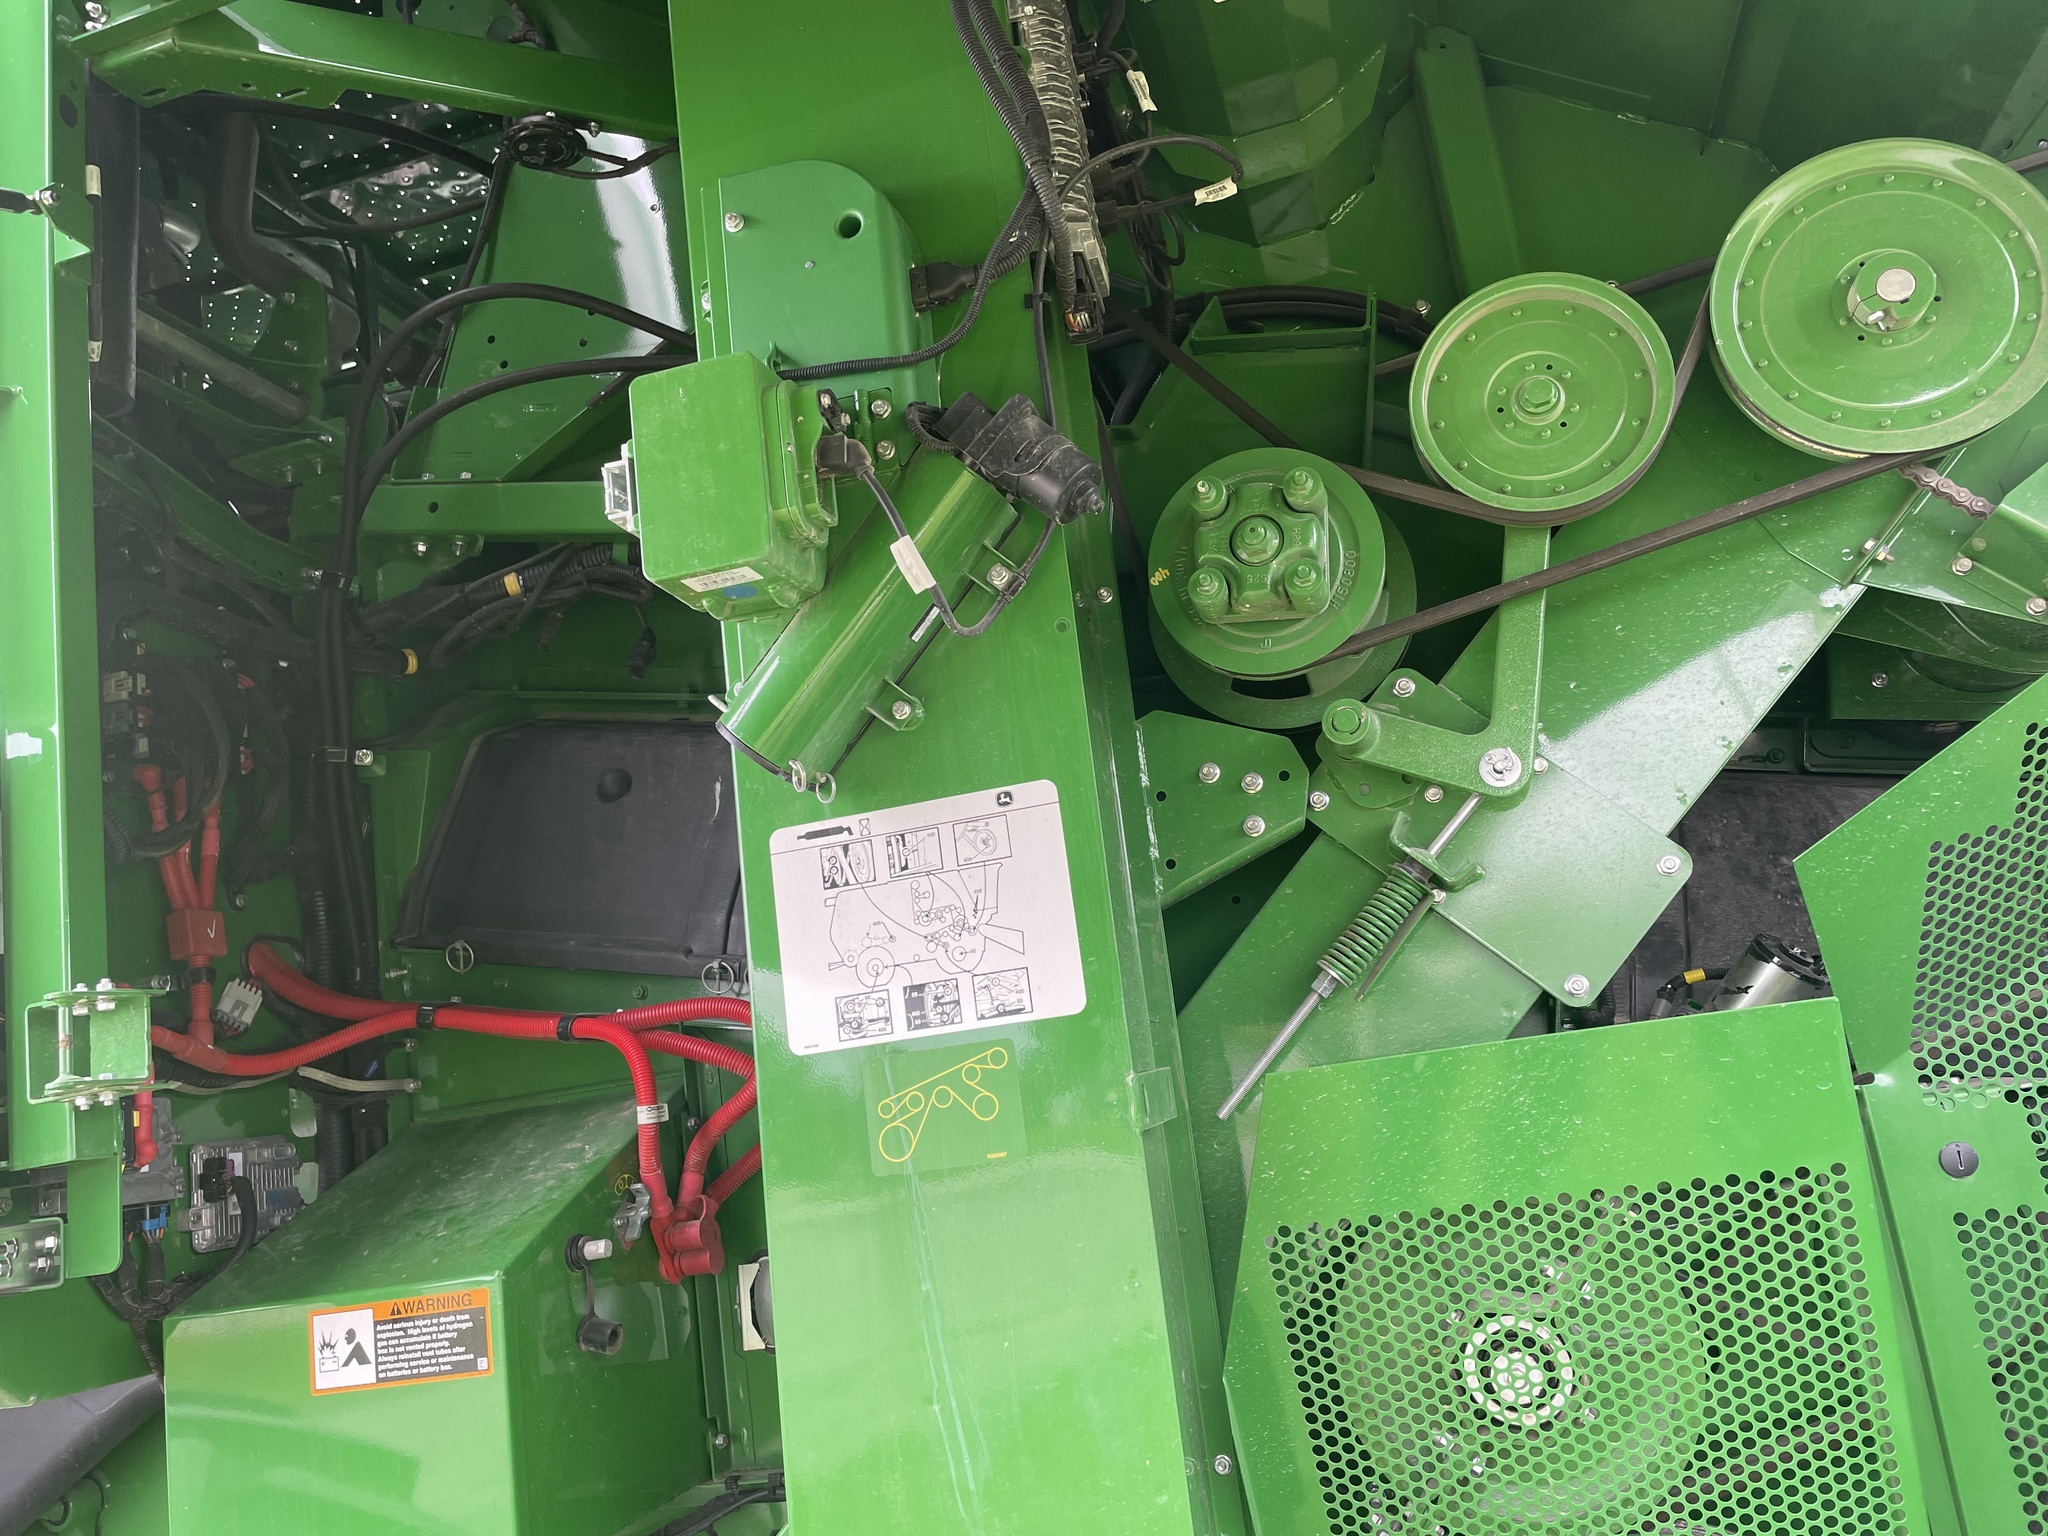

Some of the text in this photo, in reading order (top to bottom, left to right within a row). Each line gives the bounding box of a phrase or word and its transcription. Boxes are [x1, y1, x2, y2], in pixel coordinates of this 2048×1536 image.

[402, 1293, 472, 1314] WARNING
[376, 1323, 392, 1331] Avoid
[393, 1320, 414, 1329] serious
[415, 1317, 431, 1327] injury
[439, 1315, 455, 1323] death
[376, 1329, 405, 1340] explosion.
[407, 1327, 421, 1336] High
[422, 1325, 438, 1333] levels
[446, 1321, 474, 1331] hydrogen
[377, 1339, 388, 1348] gas
[399, 1335, 432, 1344] accumulate
[437, 1331, 458, 1340] battery
[377, 1346, 388, 1354] box
[406, 1342, 424, 1350] vented
[425, 1340, 450, 1350] properly.
[378, 1353, 398, 1362] Always
[398, 1351, 421, 1360] reinstall
[378, 1361, 409, 1372] performing
[409, 1359, 430, 1367] service
[438, 1353, 475, 1363] maintenance
[387, 1369, 412, 1377] batteries
[419, 1365, 440, 1374] battery
[440, 1363, 453, 1371] box.
